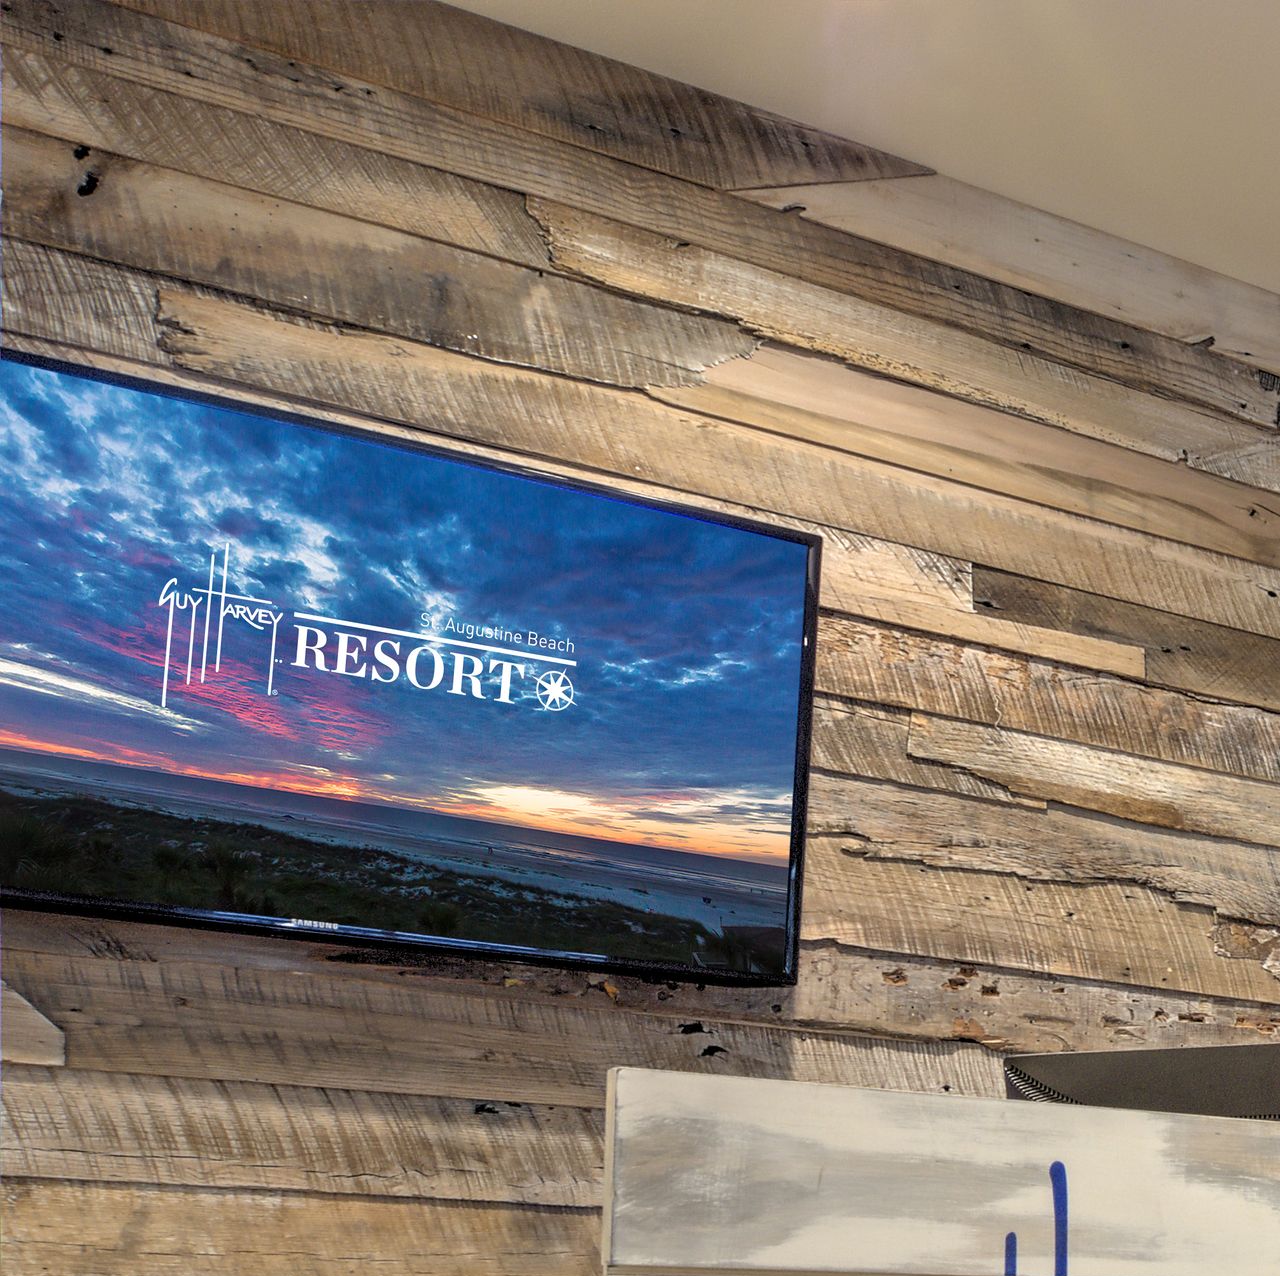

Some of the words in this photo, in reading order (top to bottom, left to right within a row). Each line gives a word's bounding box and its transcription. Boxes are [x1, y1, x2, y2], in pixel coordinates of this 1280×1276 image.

[159, 577, 203, 708] GUY
[290, 624, 525, 705] RESORT
[420, 612, 439, 630] St.
[445, 617, 522, 644] Augustine
[527, 631, 576, 653] Beach
